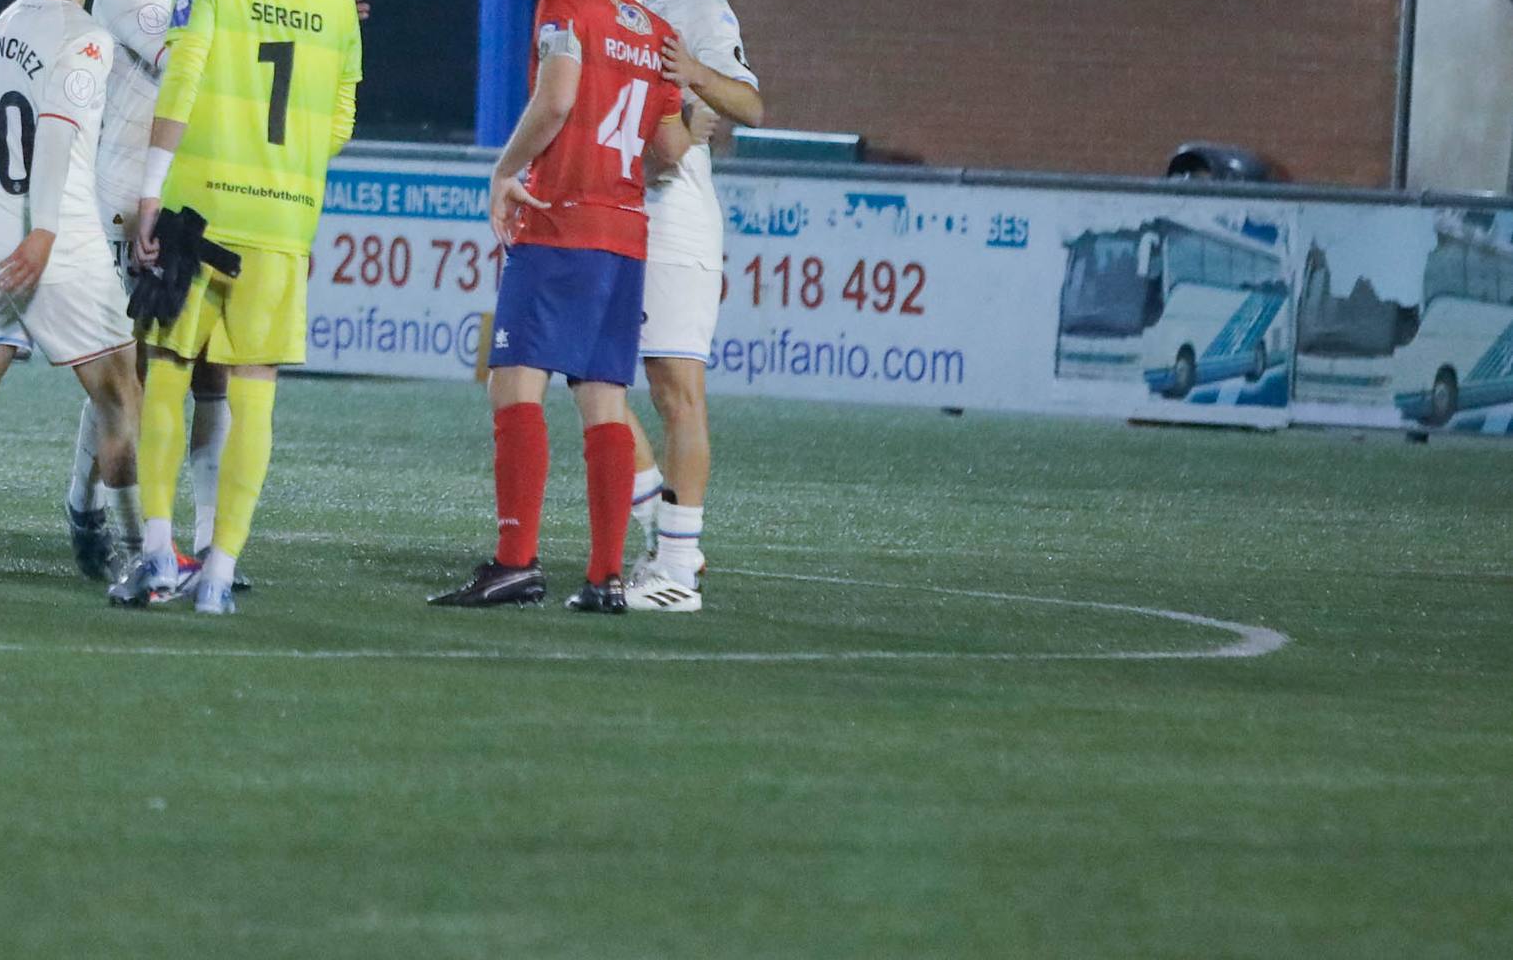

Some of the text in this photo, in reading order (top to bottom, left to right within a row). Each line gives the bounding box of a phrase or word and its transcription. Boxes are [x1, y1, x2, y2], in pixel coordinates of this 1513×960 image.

[251, 2, 323, 33] SERGIO
[258, 41, 295, 146] 1
[597, 78, 649, 180] 4
[332, 233, 412, 288] 280
[744, 254, 825, 309] 118
[842, 259, 927, 316] 492
